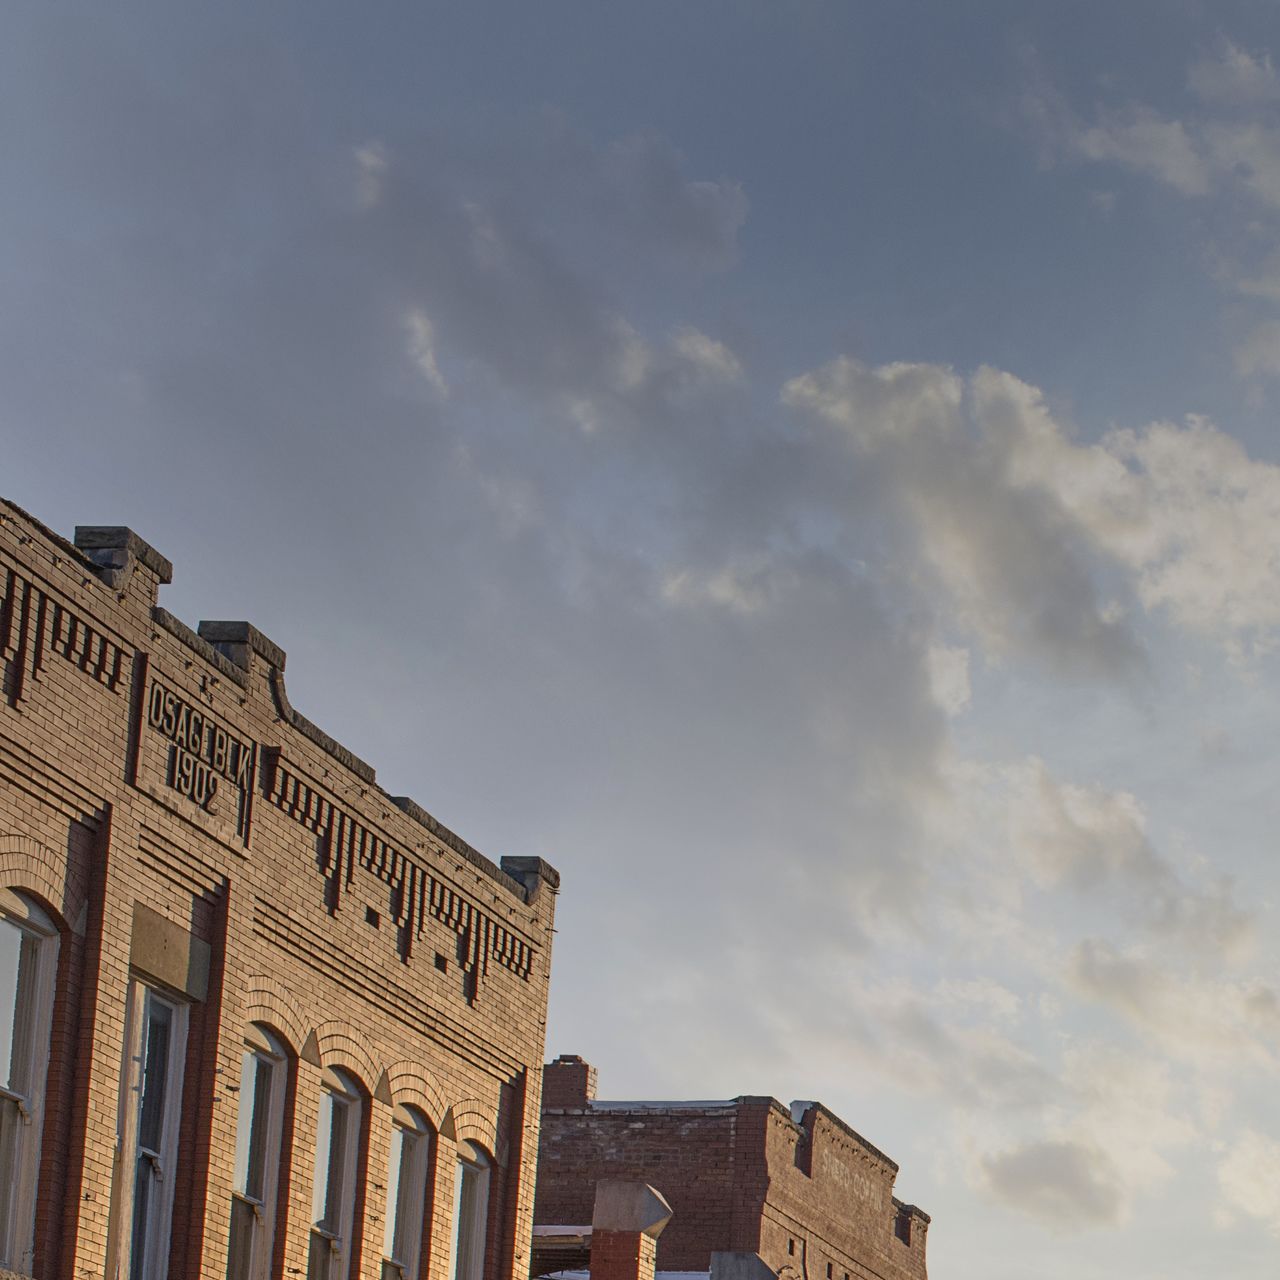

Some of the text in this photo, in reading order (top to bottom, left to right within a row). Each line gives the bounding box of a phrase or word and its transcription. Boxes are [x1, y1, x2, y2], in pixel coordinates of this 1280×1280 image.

[150, 682, 251, 793] OSAGE BLK
[174, 745, 219, 816] 1902
